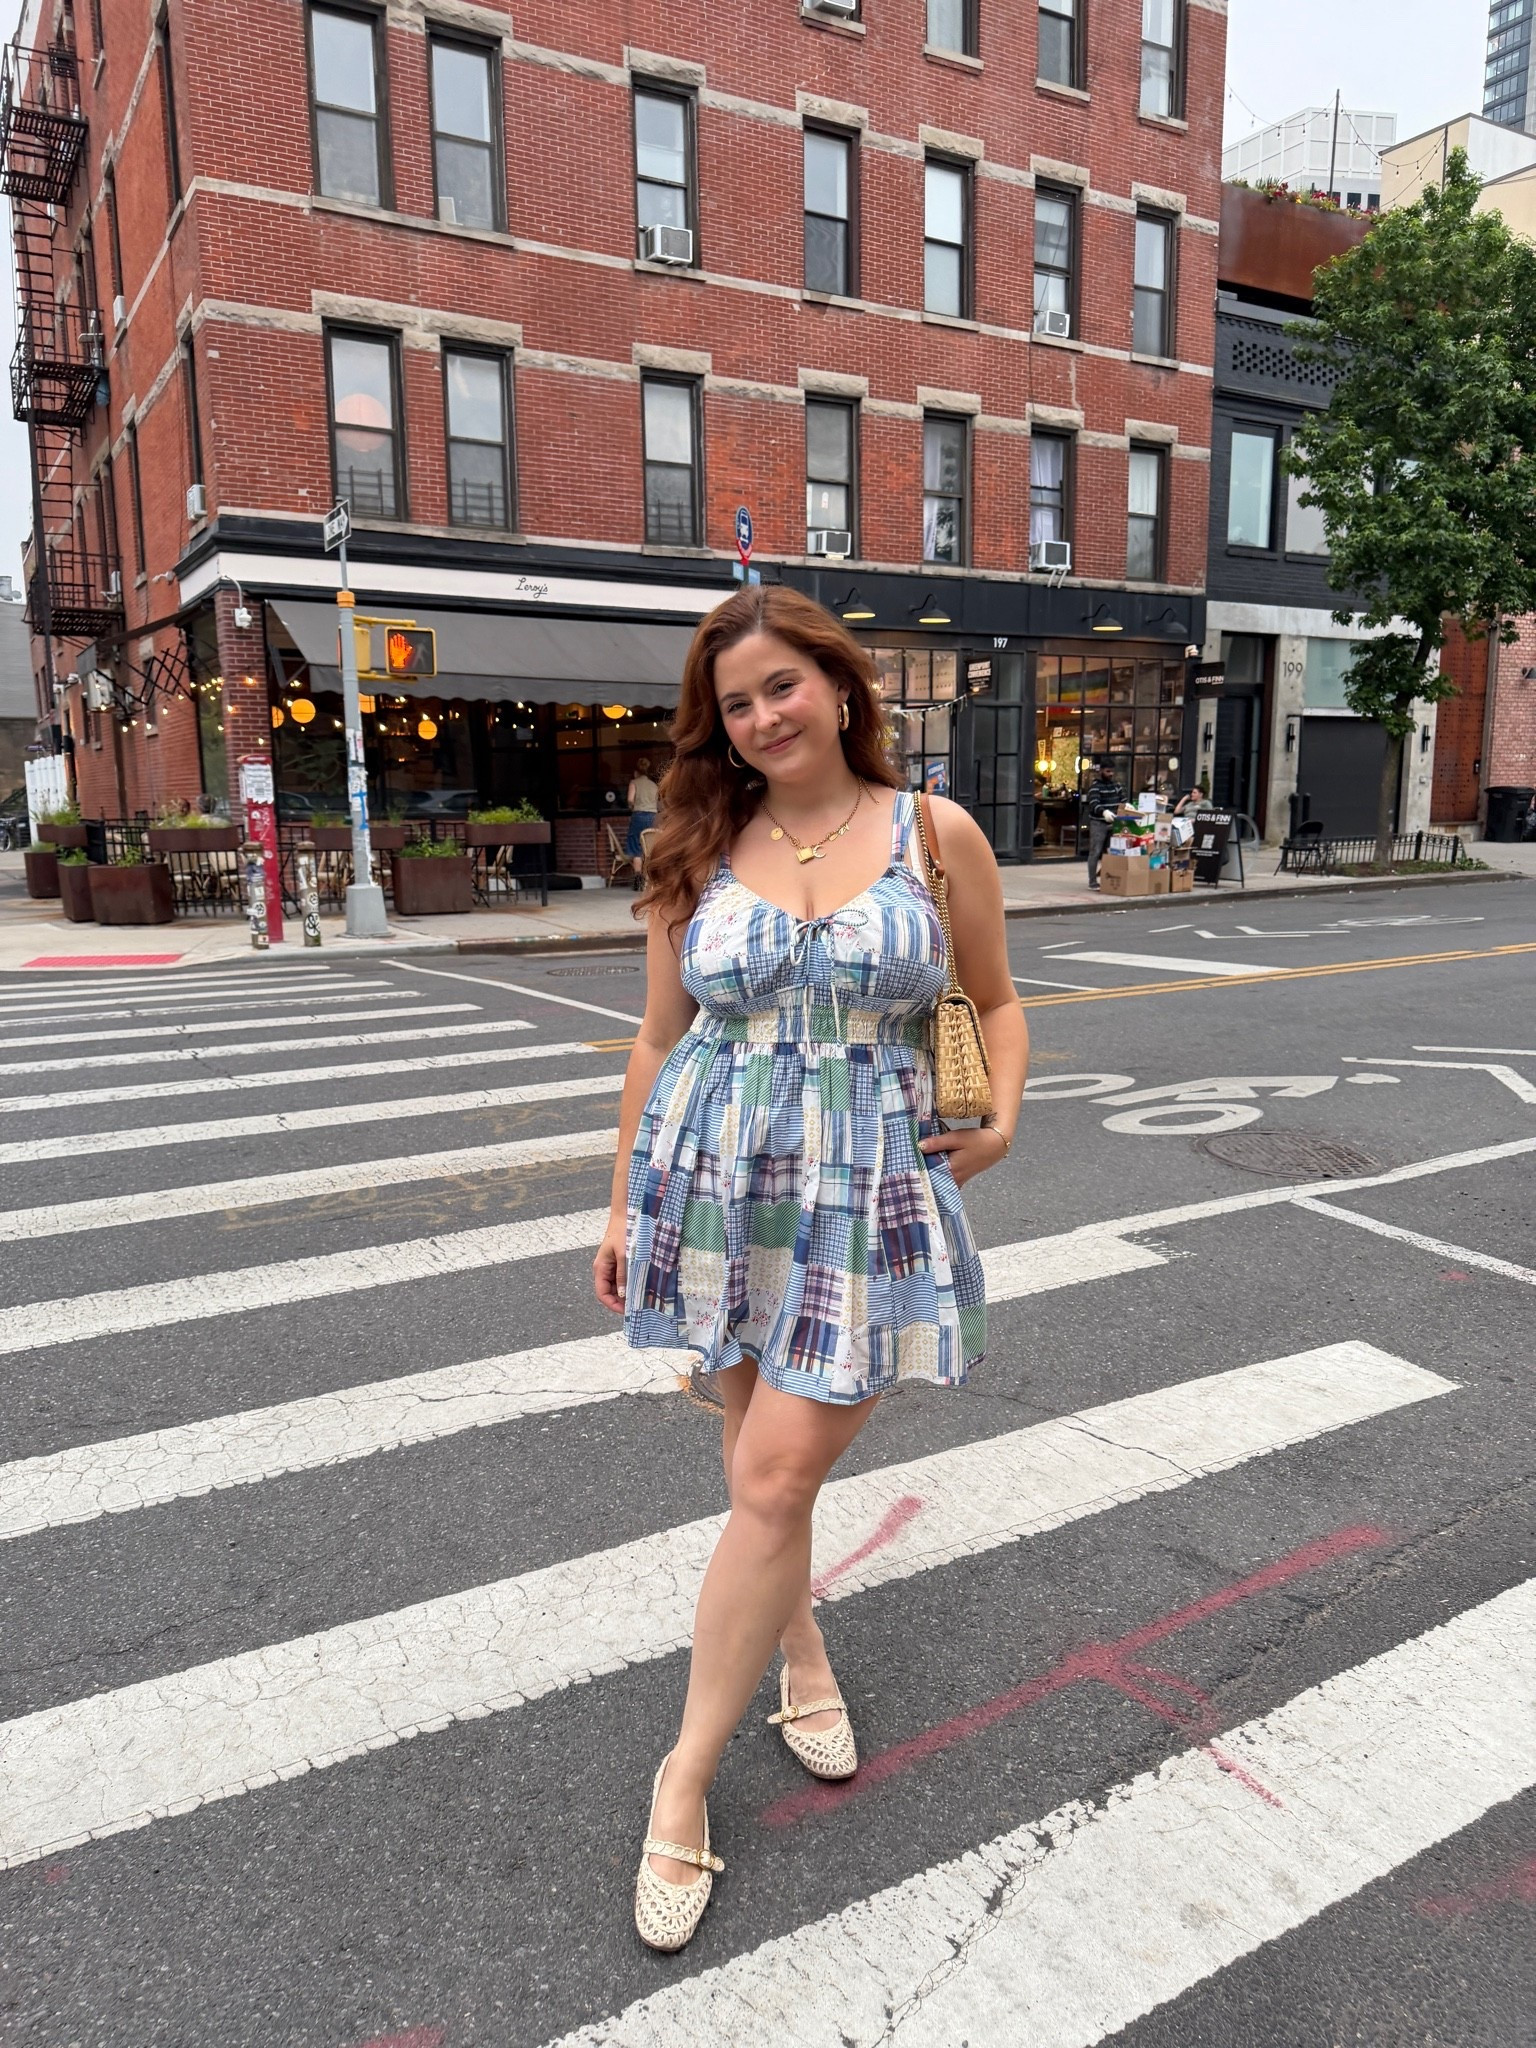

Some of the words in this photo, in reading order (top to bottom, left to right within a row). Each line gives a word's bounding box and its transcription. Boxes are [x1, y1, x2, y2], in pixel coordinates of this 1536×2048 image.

[515, 577, 549, 599] Leroy's
[993, 637, 1008, 649] 197
[1283, 661, 1303, 677] 199
[1195, 676, 1207, 684] OTIS
[1197, 813, 1211, 821] OTIS
[1216, 814, 1231, 822] FINN
